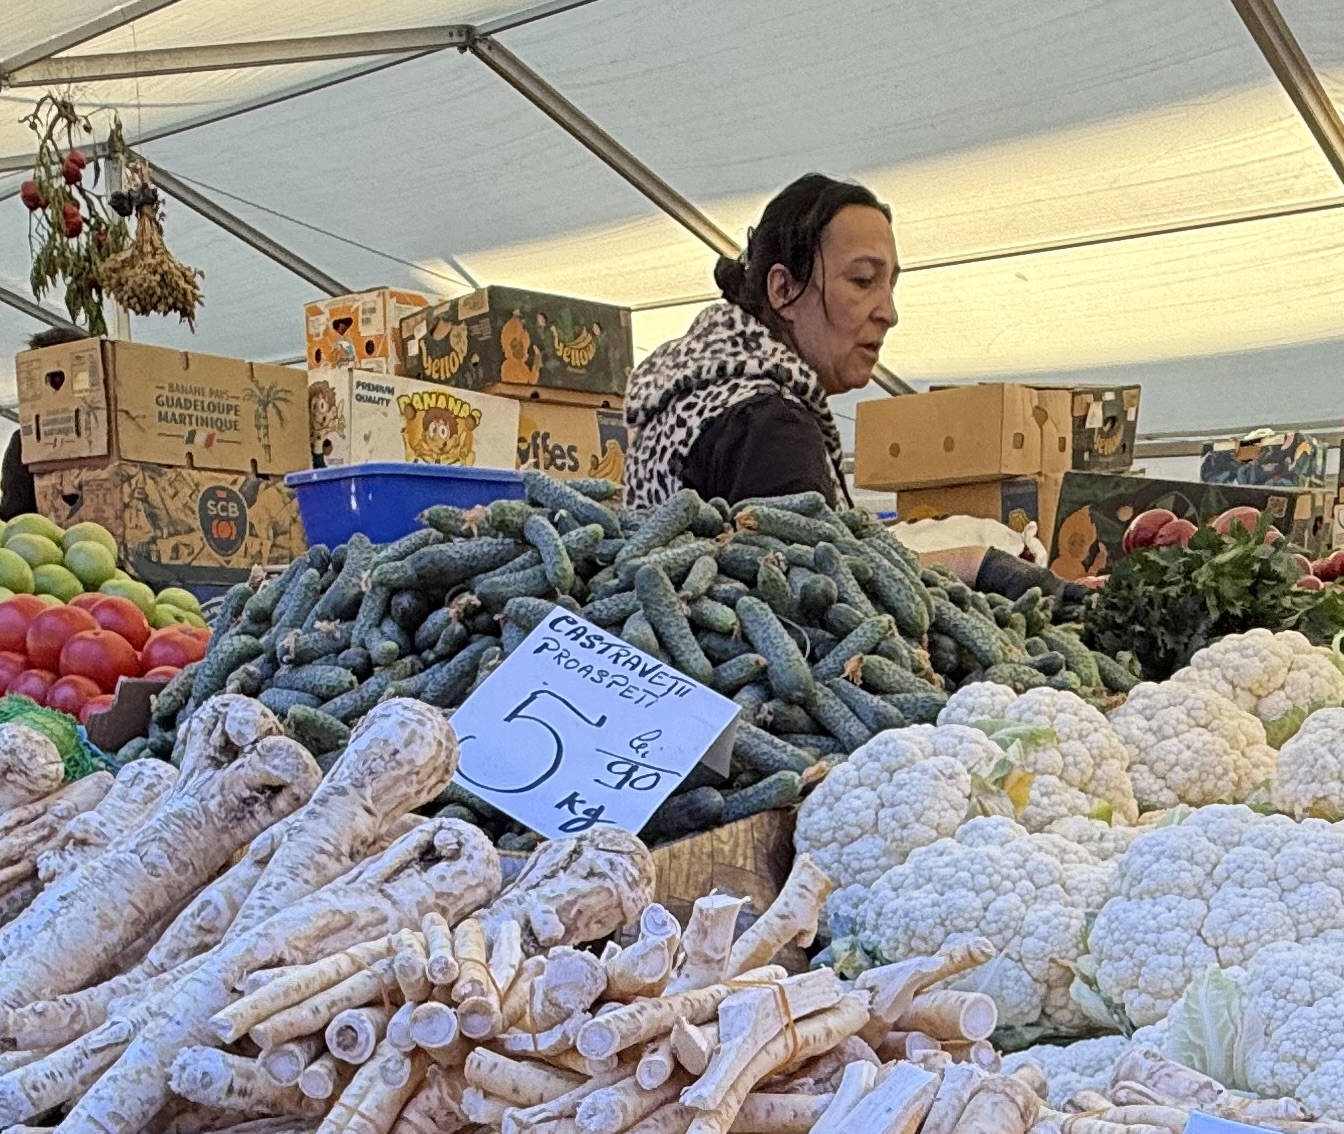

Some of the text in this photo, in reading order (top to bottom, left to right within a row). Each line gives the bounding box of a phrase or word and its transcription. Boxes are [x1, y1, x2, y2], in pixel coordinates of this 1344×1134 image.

[356, 381, 395, 396] PREMIUM
[156, 394, 241, 417] GUADELOUPE
[355, 394, 391, 407] QUALITY
[158, 410, 241, 432] MARTINIQUE
[206, 500, 241, 518] SCB
[455, 688, 608, 794] 5
